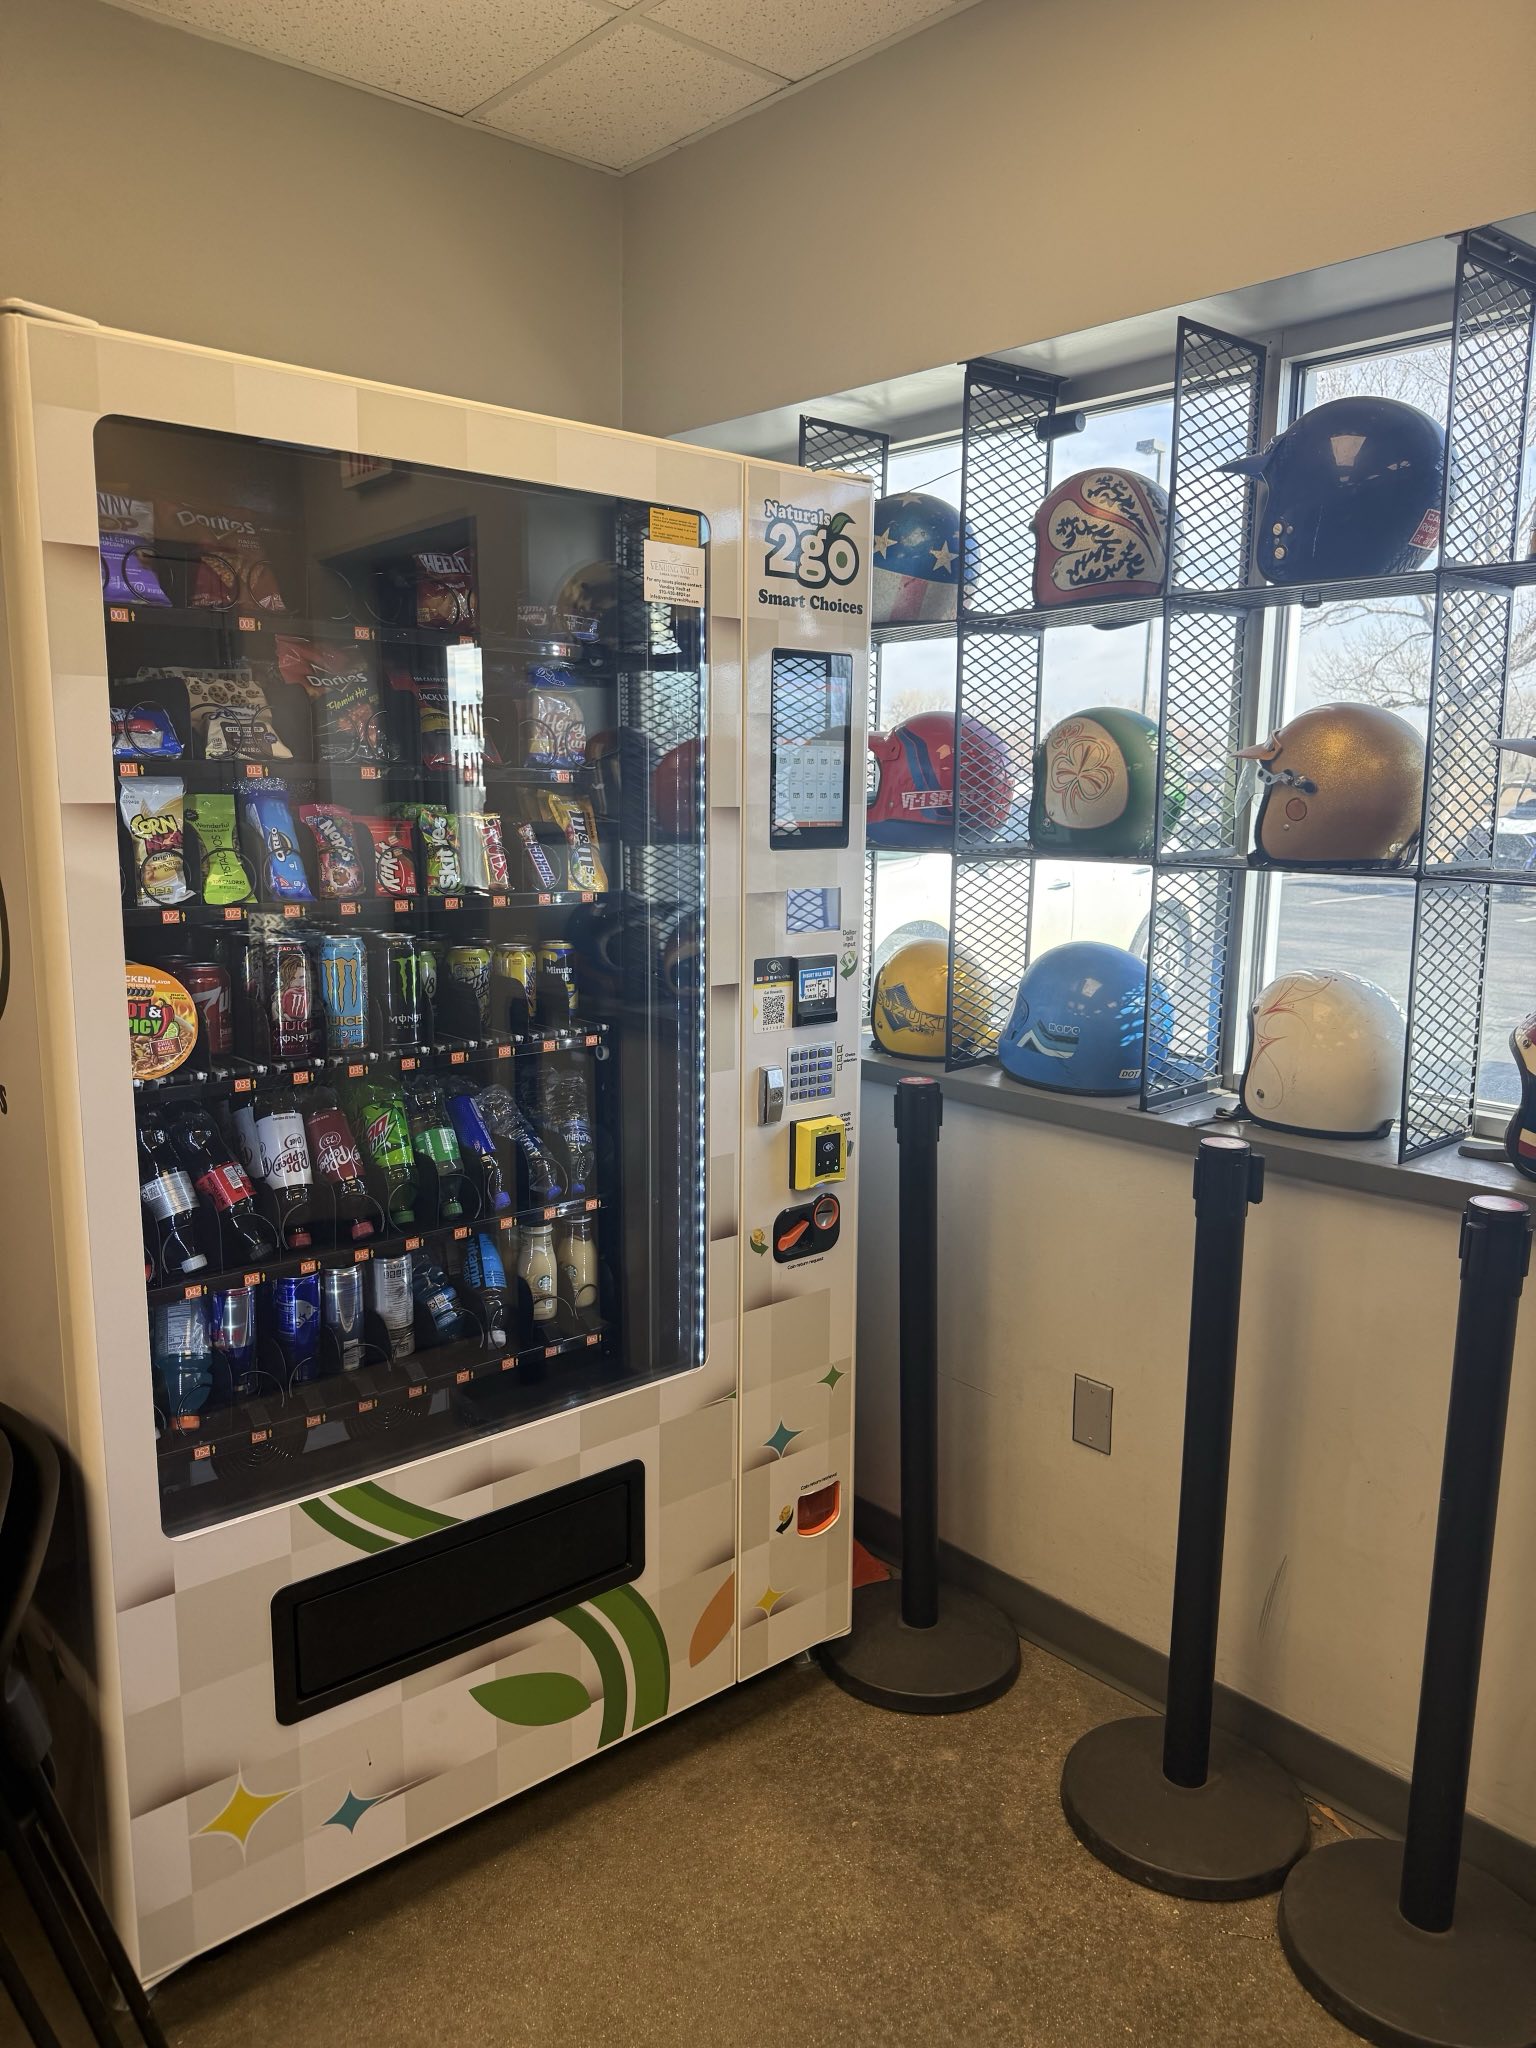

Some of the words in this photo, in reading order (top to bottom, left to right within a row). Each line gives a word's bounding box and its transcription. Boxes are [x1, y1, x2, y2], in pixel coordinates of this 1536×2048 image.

[765, 499, 831, 525] Naturals
[176, 510, 256, 535] Doritos
[765, 518, 860, 589] 2go
[758, 589, 805, 608] Smart
[810, 595, 863, 615] Choices
[110, 609, 127, 621] 001
[239, 618, 254, 630] 003
[355, 629, 369, 638] 005
[306, 673, 368, 687] Doritos
[121, 765, 137, 775] 011
[247, 766, 262, 775] 013
[362, 769, 375, 777] 015
[130, 814, 178, 839] CORN
[271, 827, 287, 862] OREO
[482, 817, 508, 881] TWIX
[212, 835, 231, 877] PISTACIOS
[395, 902, 408, 911] 026
[446, 900, 458, 909] 027
[494, 897, 506, 906] 028
[285, 907, 300, 917] 024
[342, 904, 355, 913] 025
[163, 914, 179, 922] 022
[226, 910, 241, 919] 023
[546, 966, 572, 974] Minute
[125, 975, 150, 983] CKEN
[128, 1003, 149, 1018] OT
[149, 1007, 162, 1018] &
[877, 991, 946, 1030] SUZUKI
[129, 1018, 160, 1034] PICY
[544, 1042, 555, 1050] 039
[451, 1053, 464, 1063] 037
[402, 1059, 415, 1068] 036
[350, 1065, 363, 1074] 035
[1121, 1070, 1140, 1079] DOT
[293, 1073, 308, 1083] 034
[236, 1080, 250, 1090] 033
[276, 1149, 309, 1172] Pepper
[586, 1200, 597, 1209] 050
[501, 1218, 512, 1227] 048
[455, 1229, 467, 1239] 047
[355, 1250, 369, 1260] 045
[301, 1262, 316, 1272] 044
[468, 1238, 483, 1288] vitamin
[245, 1275, 259, 1285] 043
[186, 1286, 201, 1297] 042
[587, 1335, 598, 1344] 060
[502, 1359, 514, 1369] 058
[457, 1372, 469, 1382] 057
[307, 1416, 321, 1426] 054
[195, 1447, 210, 1458] 052
